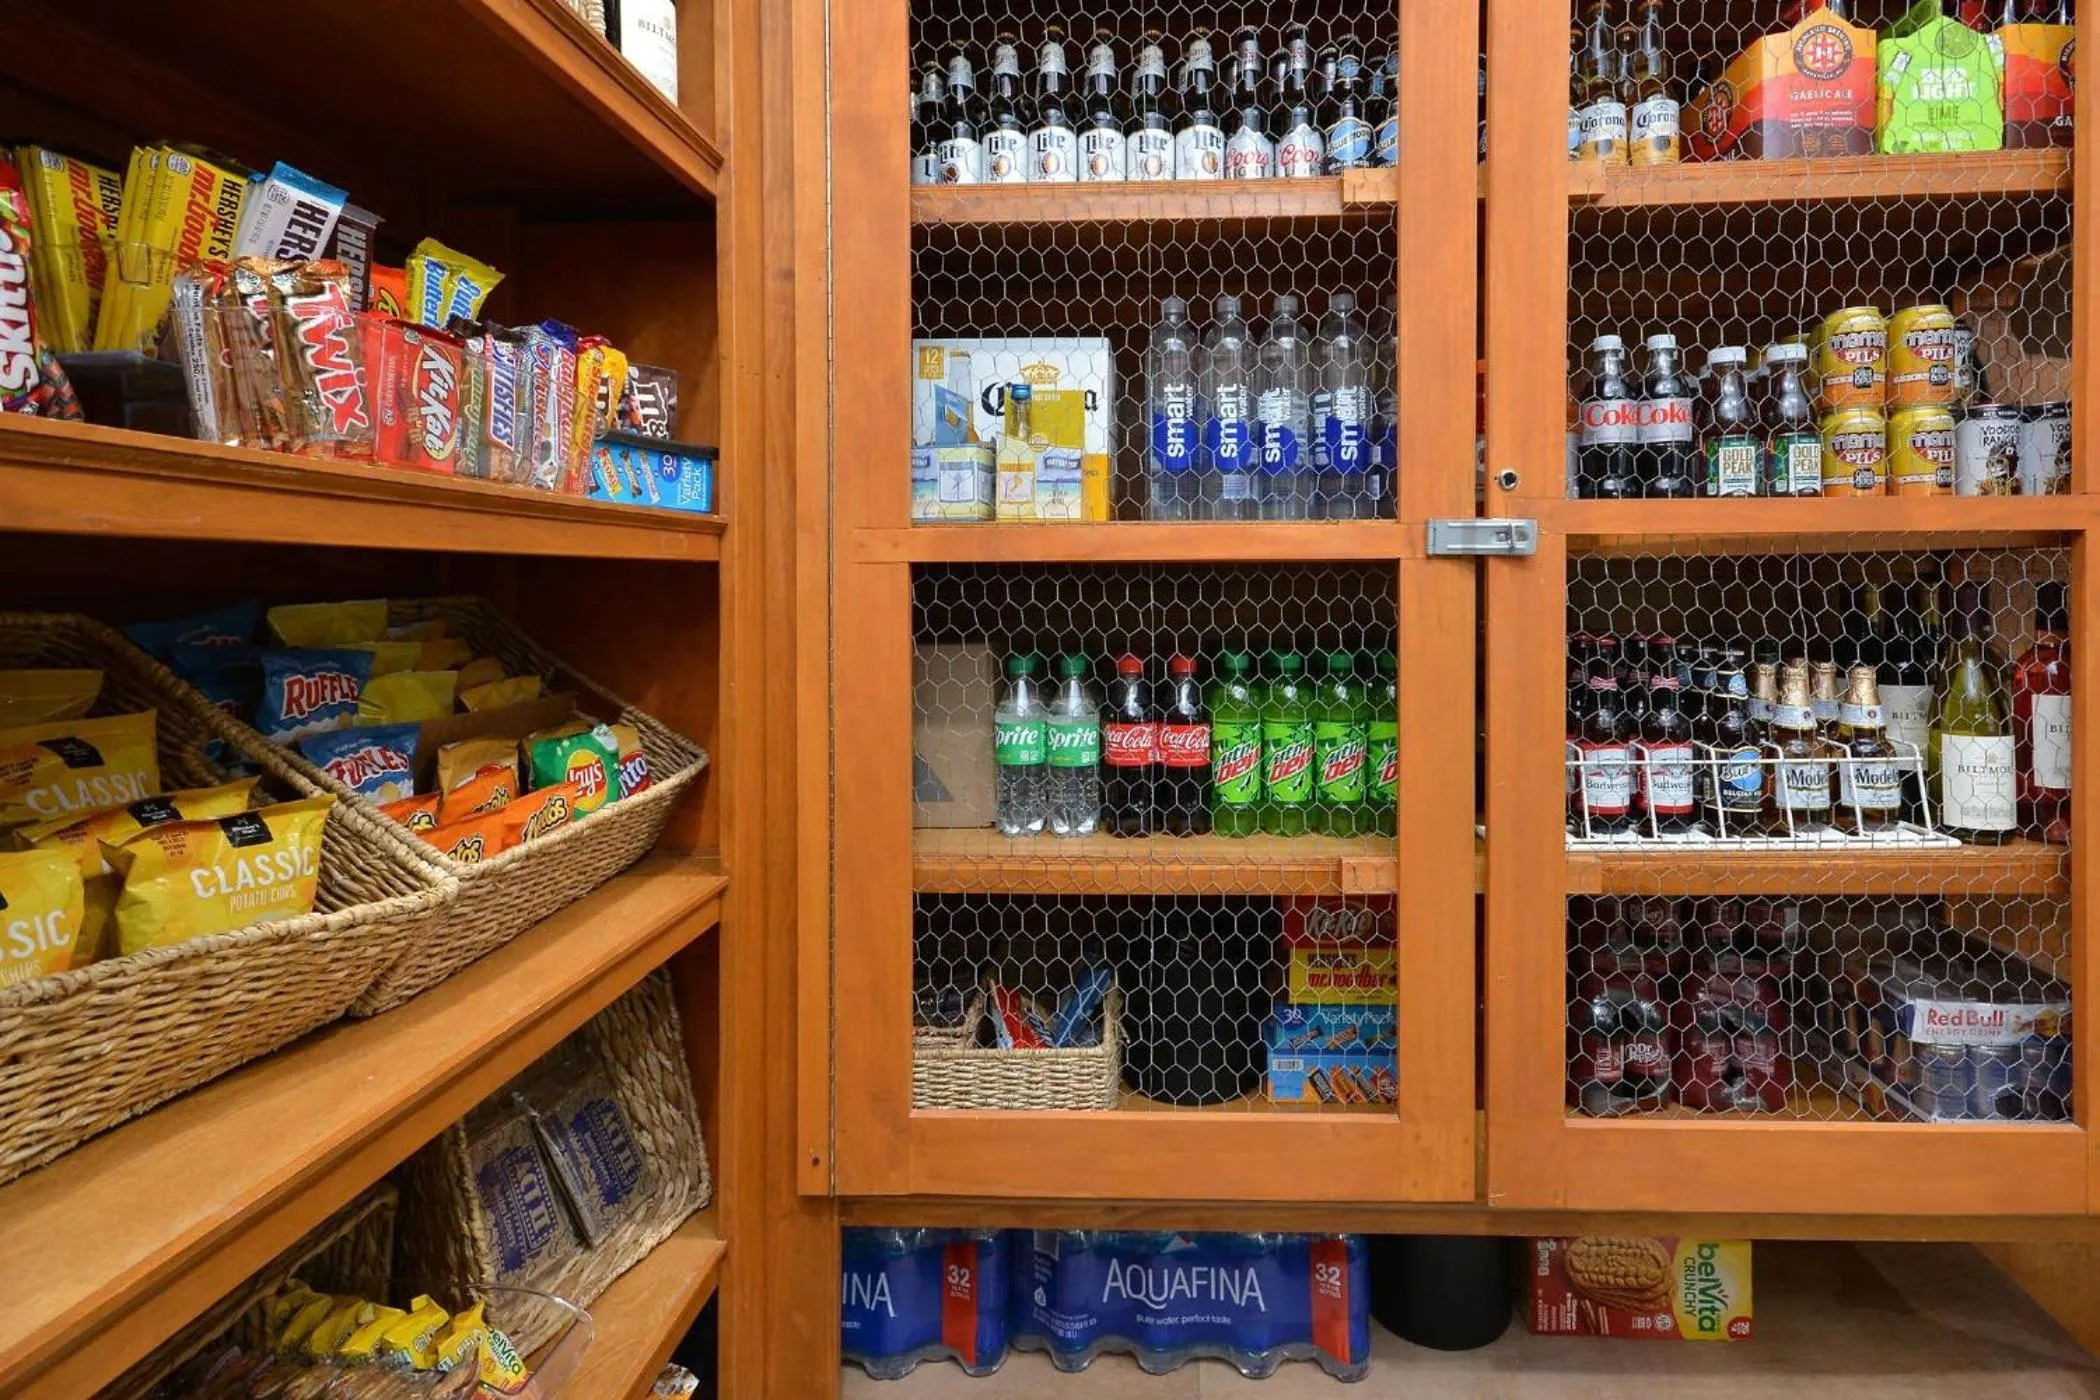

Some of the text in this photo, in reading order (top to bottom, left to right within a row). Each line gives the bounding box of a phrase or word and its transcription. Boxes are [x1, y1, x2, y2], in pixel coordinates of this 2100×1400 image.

[1791, 88, 1853, 101] GAELIC ALE
[1912, 81, 1976, 101] LIGHT
[1928, 104, 1960, 122] LIME
[988, 137, 1018, 155] Lite
[1037, 132, 1066, 152] Lite
[208, 178, 243, 259] HERSHEY'S
[924, 347, 940, 365] 12
[1844, 350, 1881, 363] PILS
[1185, 385, 1194, 418] water
[1238, 383, 1248, 417] water
[1163, 383, 1186, 458] smart
[1217, 383, 1239, 459] smart
[1981, 424, 2020, 436] VOODOO
[663, 454, 677, 478] 30
[1723, 447, 1752, 461] GOLD
[1723, 461, 1752, 474] PEAK
[680, 456, 695, 505] Variety
[690, 467, 702, 500] Pack
[996, 726, 1038, 748] prite
[1050, 726, 1098, 751] Sprite
[25, 771, 149, 814] CLASSIC
[190, 845, 316, 899] CLASSIC
[0, 909, 70, 961] SIC
[1928, 1008, 2004, 1027] Red Bull
[947, 1264, 971, 1288] 32
[1103, 1257, 1266, 1313] AQUAFINA
[1315, 1262, 1342, 1286] 32
[841, 1271, 897, 1318] INA
[1683, 1256, 1697, 1317] CRUNCHY
[1697, 1242, 1729, 1333] belVita
[1181, 1314, 1210, 1326] perfect
[1211, 1314, 1232, 1325] taste
